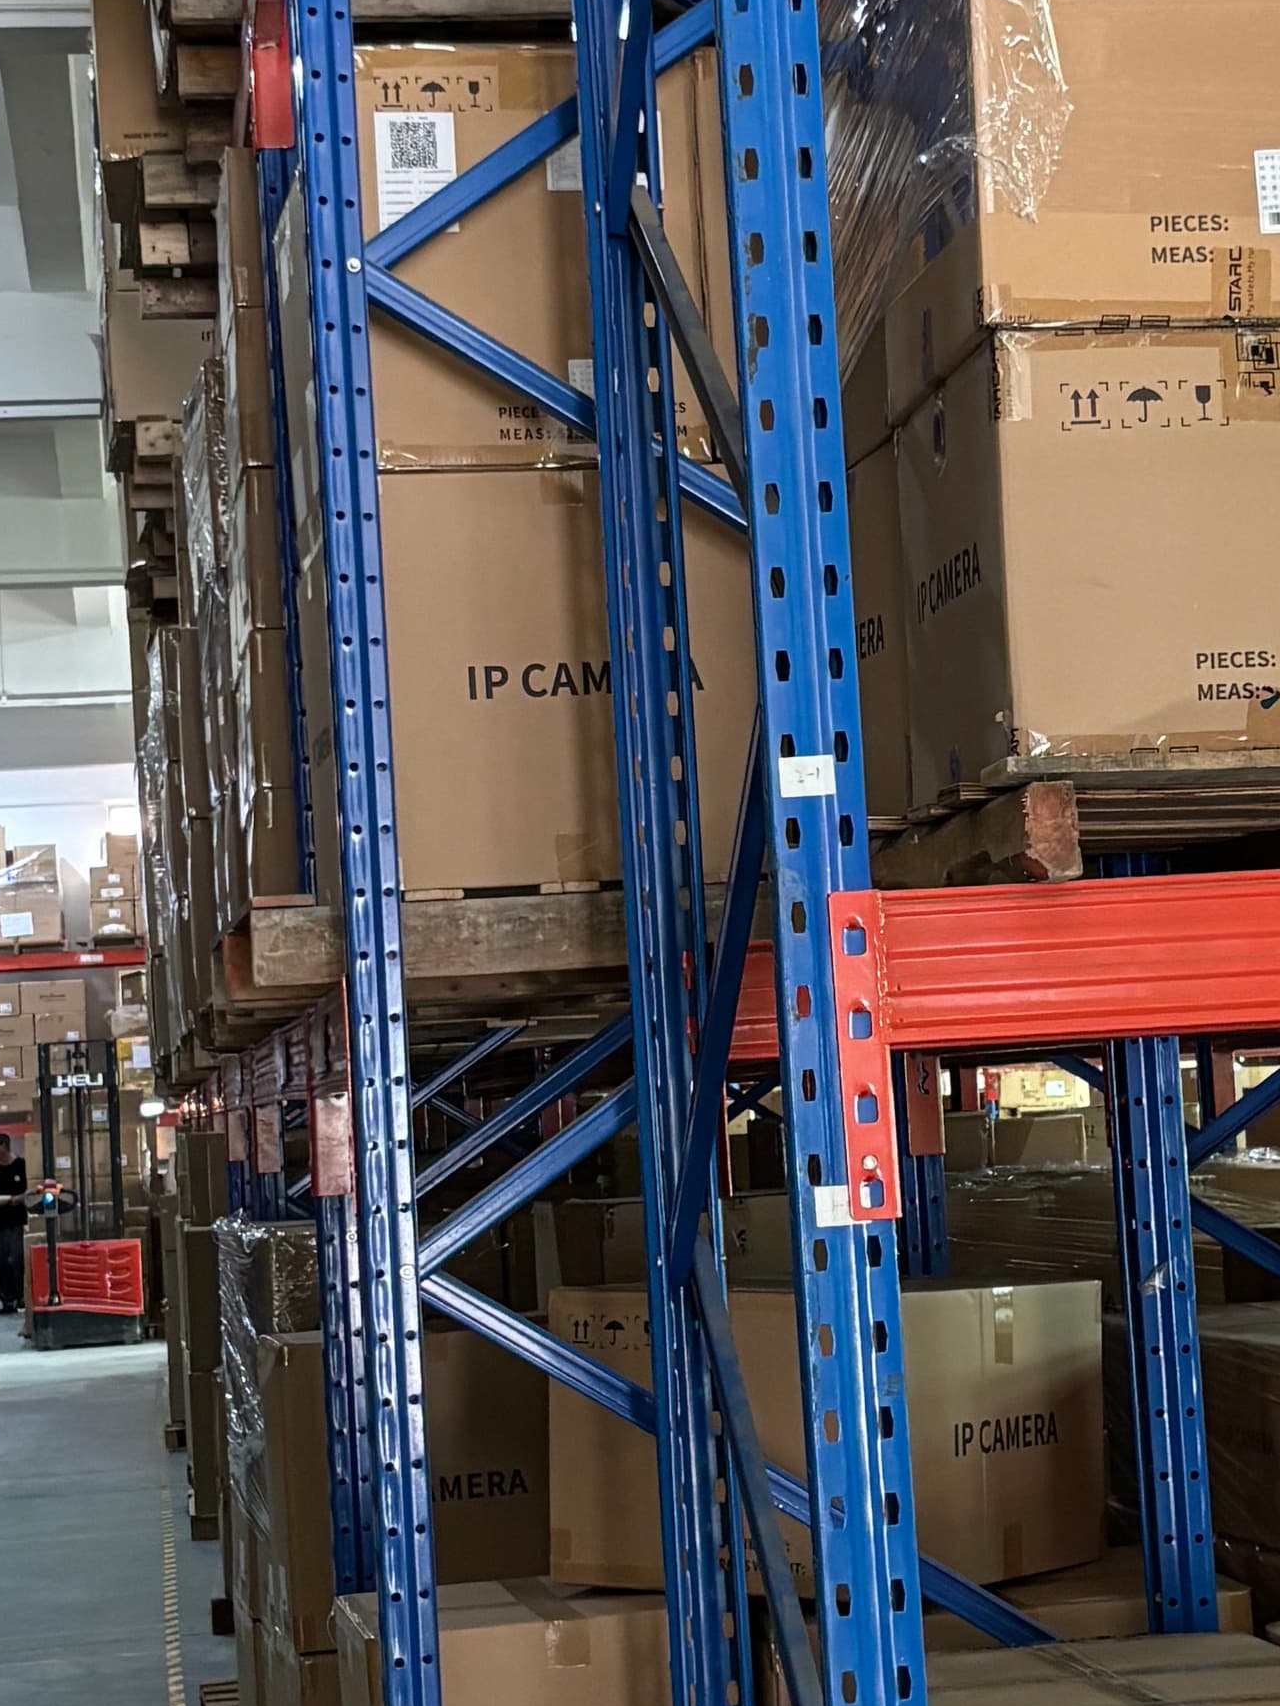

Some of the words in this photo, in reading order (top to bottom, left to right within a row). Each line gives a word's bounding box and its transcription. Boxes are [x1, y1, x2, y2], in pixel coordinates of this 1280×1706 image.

[1150, 215, 1229, 232] PIECES:
[1152, 246, 1214, 263] MEAS:
[1229, 246, 1242, 312] STARC
[928, 541, 981, 615] CAMERA
[1196, 651, 1276, 669] PIECES:
[468, 666, 508, 700] IP
[1198, 683, 1260, 701] MEAS:
[57, 1072, 104, 1087] HELI
[952, 1414, 975, 1458] IP
[979, 1410, 1059, 1455] CAMERA
